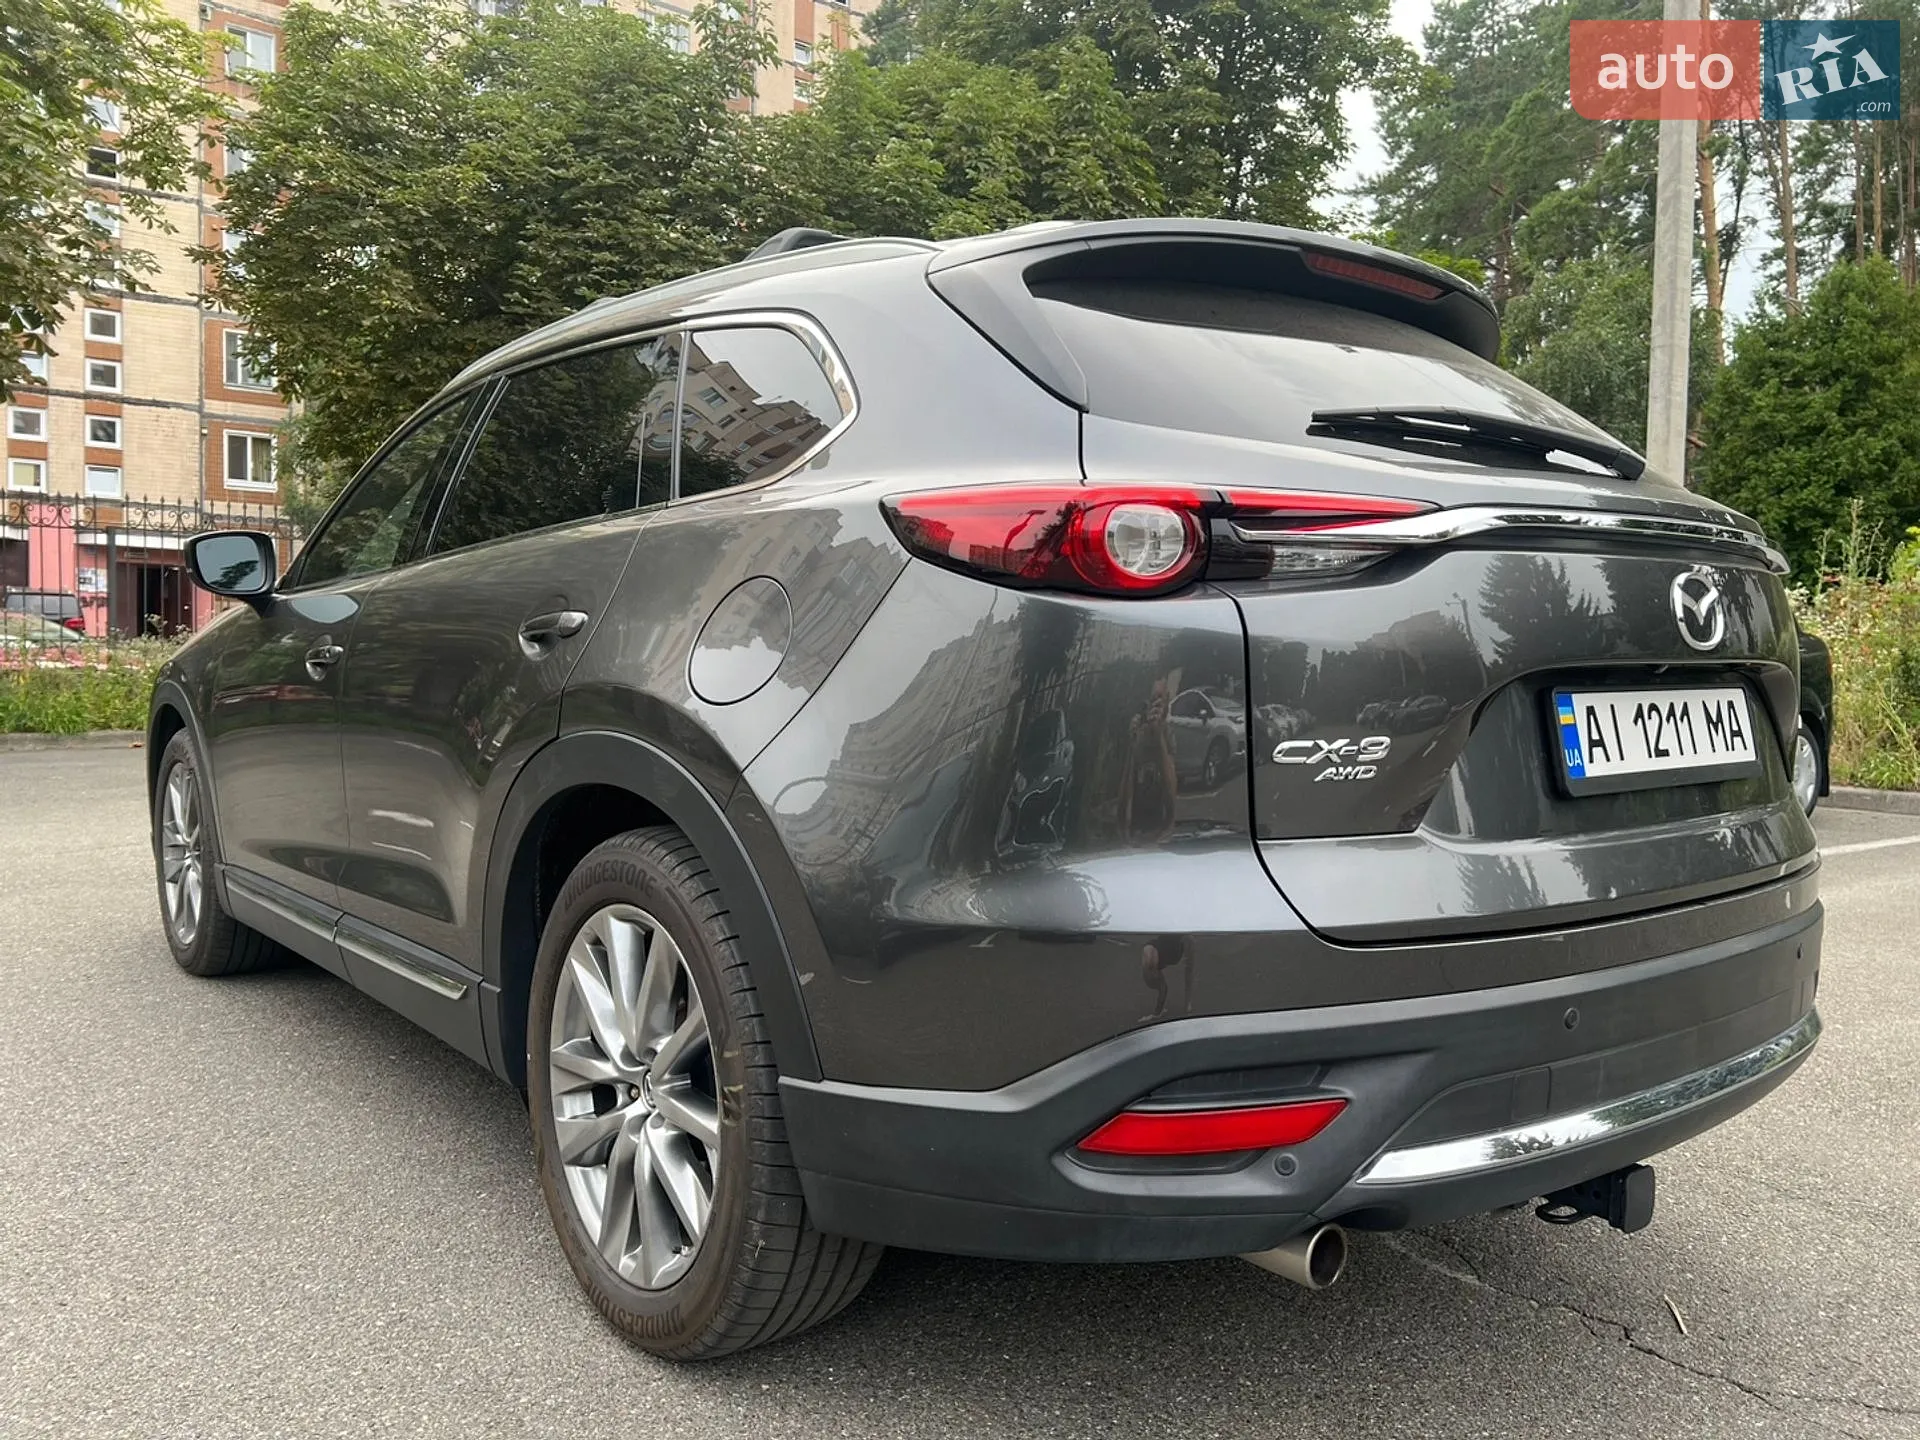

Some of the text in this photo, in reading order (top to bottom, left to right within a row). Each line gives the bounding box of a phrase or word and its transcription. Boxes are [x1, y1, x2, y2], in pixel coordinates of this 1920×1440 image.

[1585, 699, 1748, 764] AI 1211 MA
[1272, 735, 1391, 764] CX-9
[1566, 749, 1583, 768] UA
[1313, 765, 1377, 782] AWD
[564, 859, 657, 911] BRIDGESTONE
